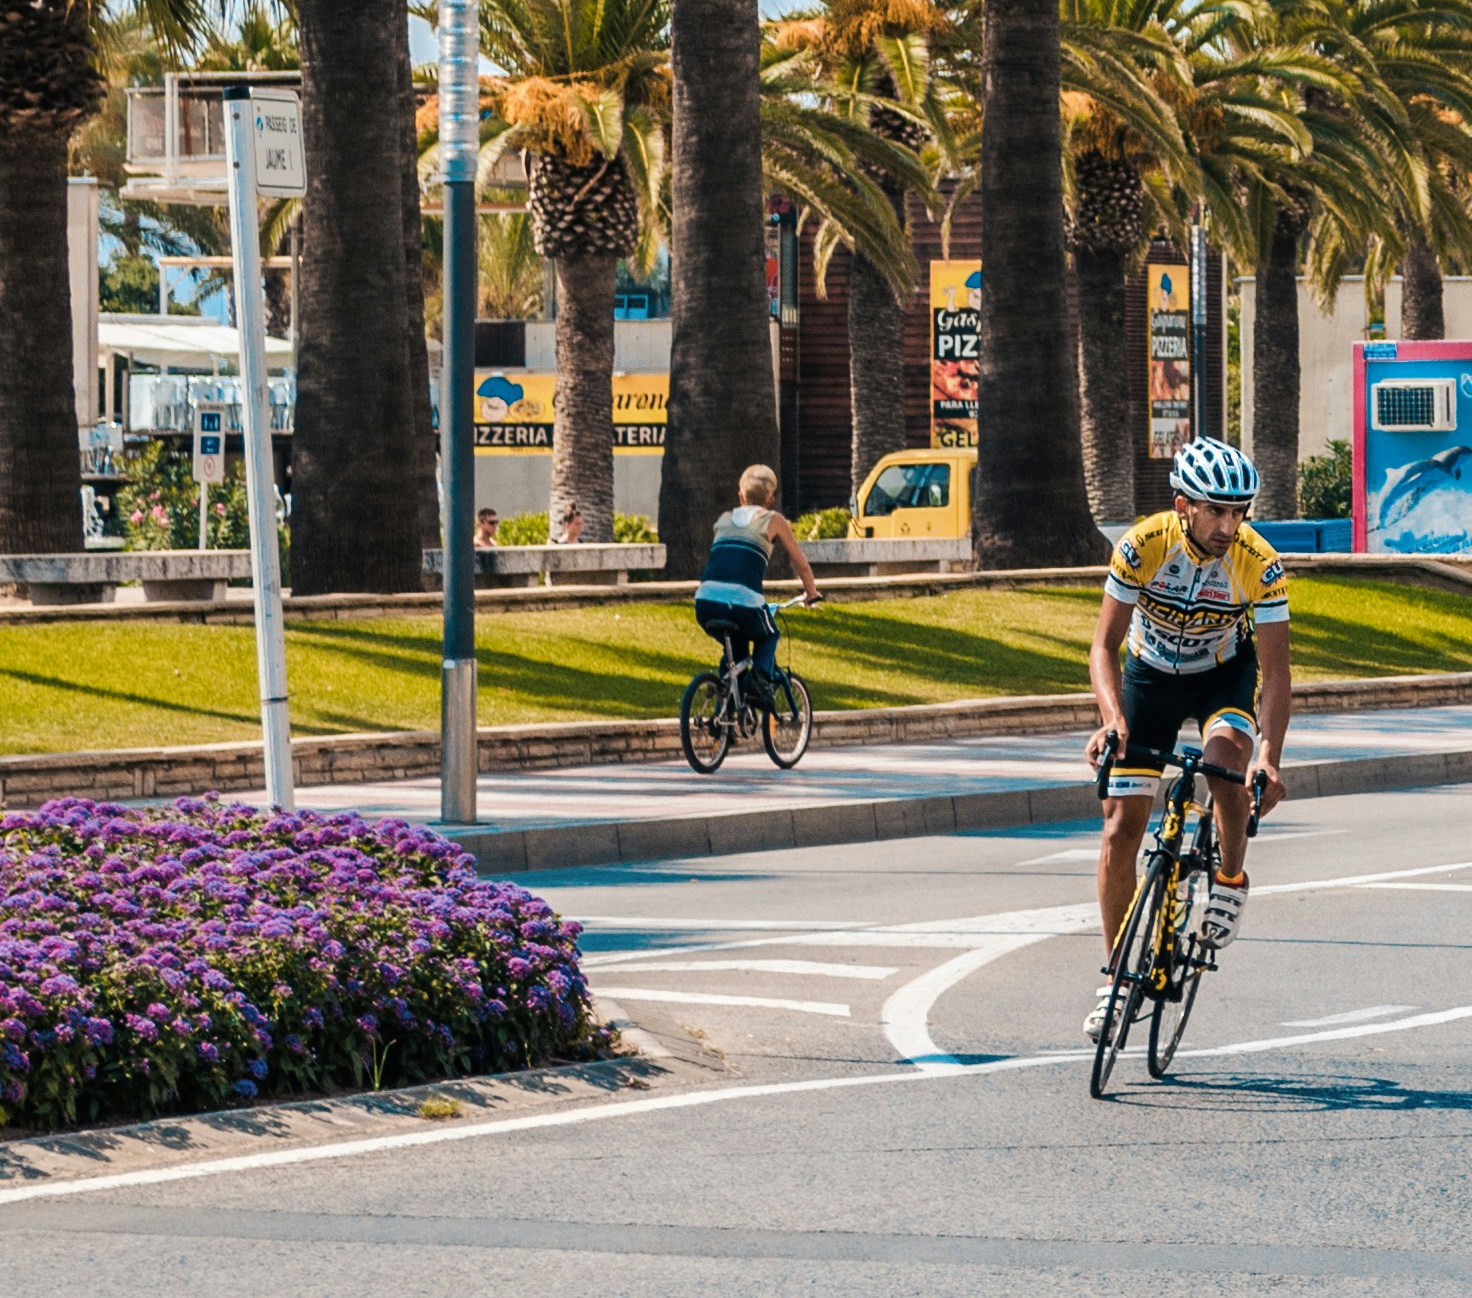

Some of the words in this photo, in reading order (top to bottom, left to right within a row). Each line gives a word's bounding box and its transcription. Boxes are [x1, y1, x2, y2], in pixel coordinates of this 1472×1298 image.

[289, 117, 298, 134] DE
[265, 148, 287, 171] JAUME
[937, 334, 981, 358] PIZ
[474, 426, 548, 445] IZZERIA
[1261, 560, 1284, 584] GU
